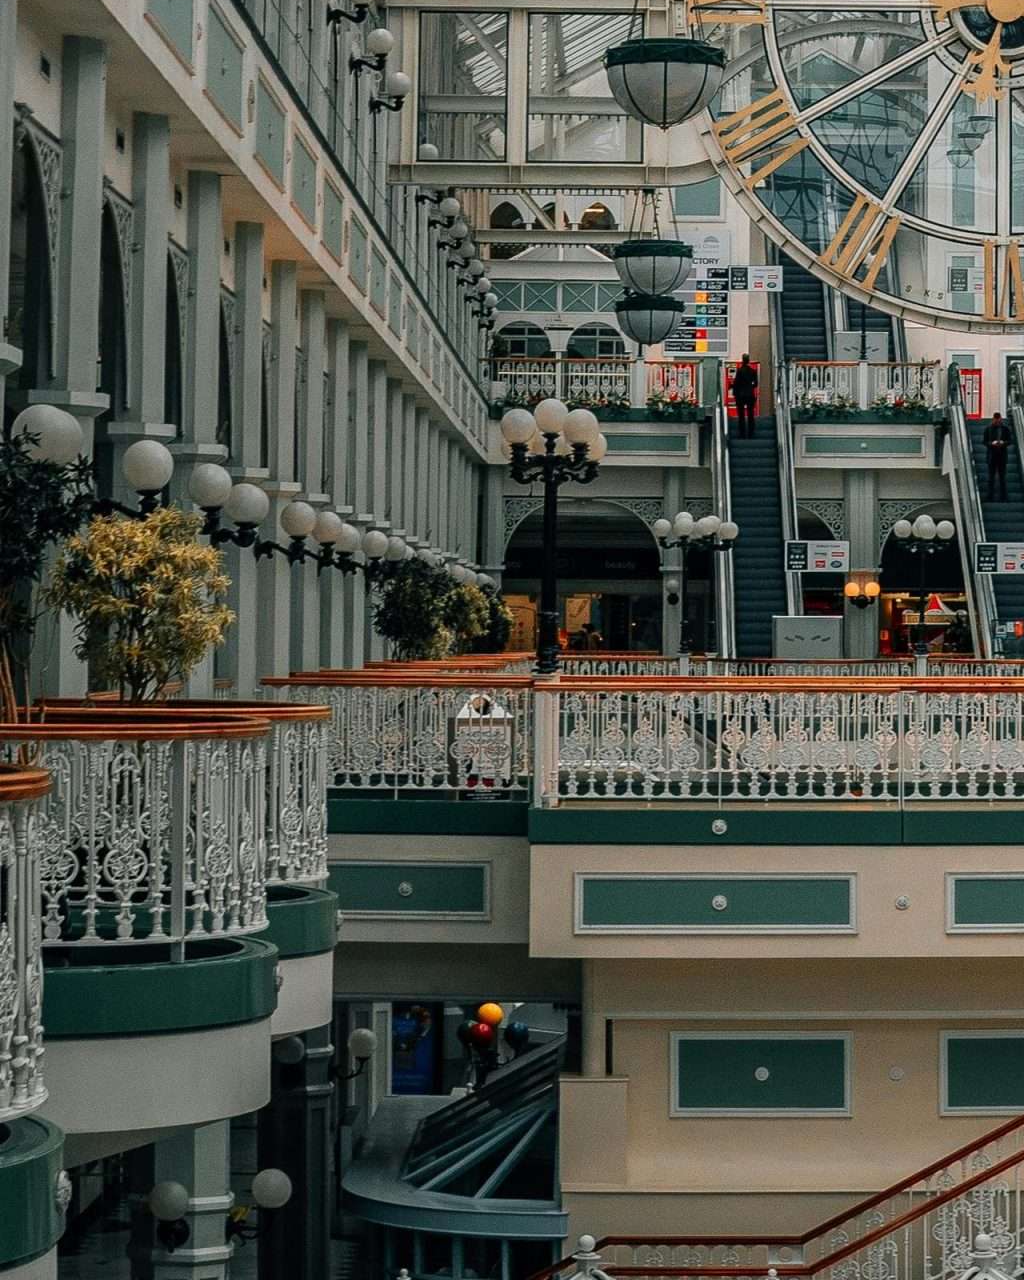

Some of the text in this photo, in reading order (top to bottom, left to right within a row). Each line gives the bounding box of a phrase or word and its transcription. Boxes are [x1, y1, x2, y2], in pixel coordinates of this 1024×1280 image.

[713, 89, 812, 191] VIII
[692, 257, 720, 265] CTORY
[818, 192, 901, 289] VII
